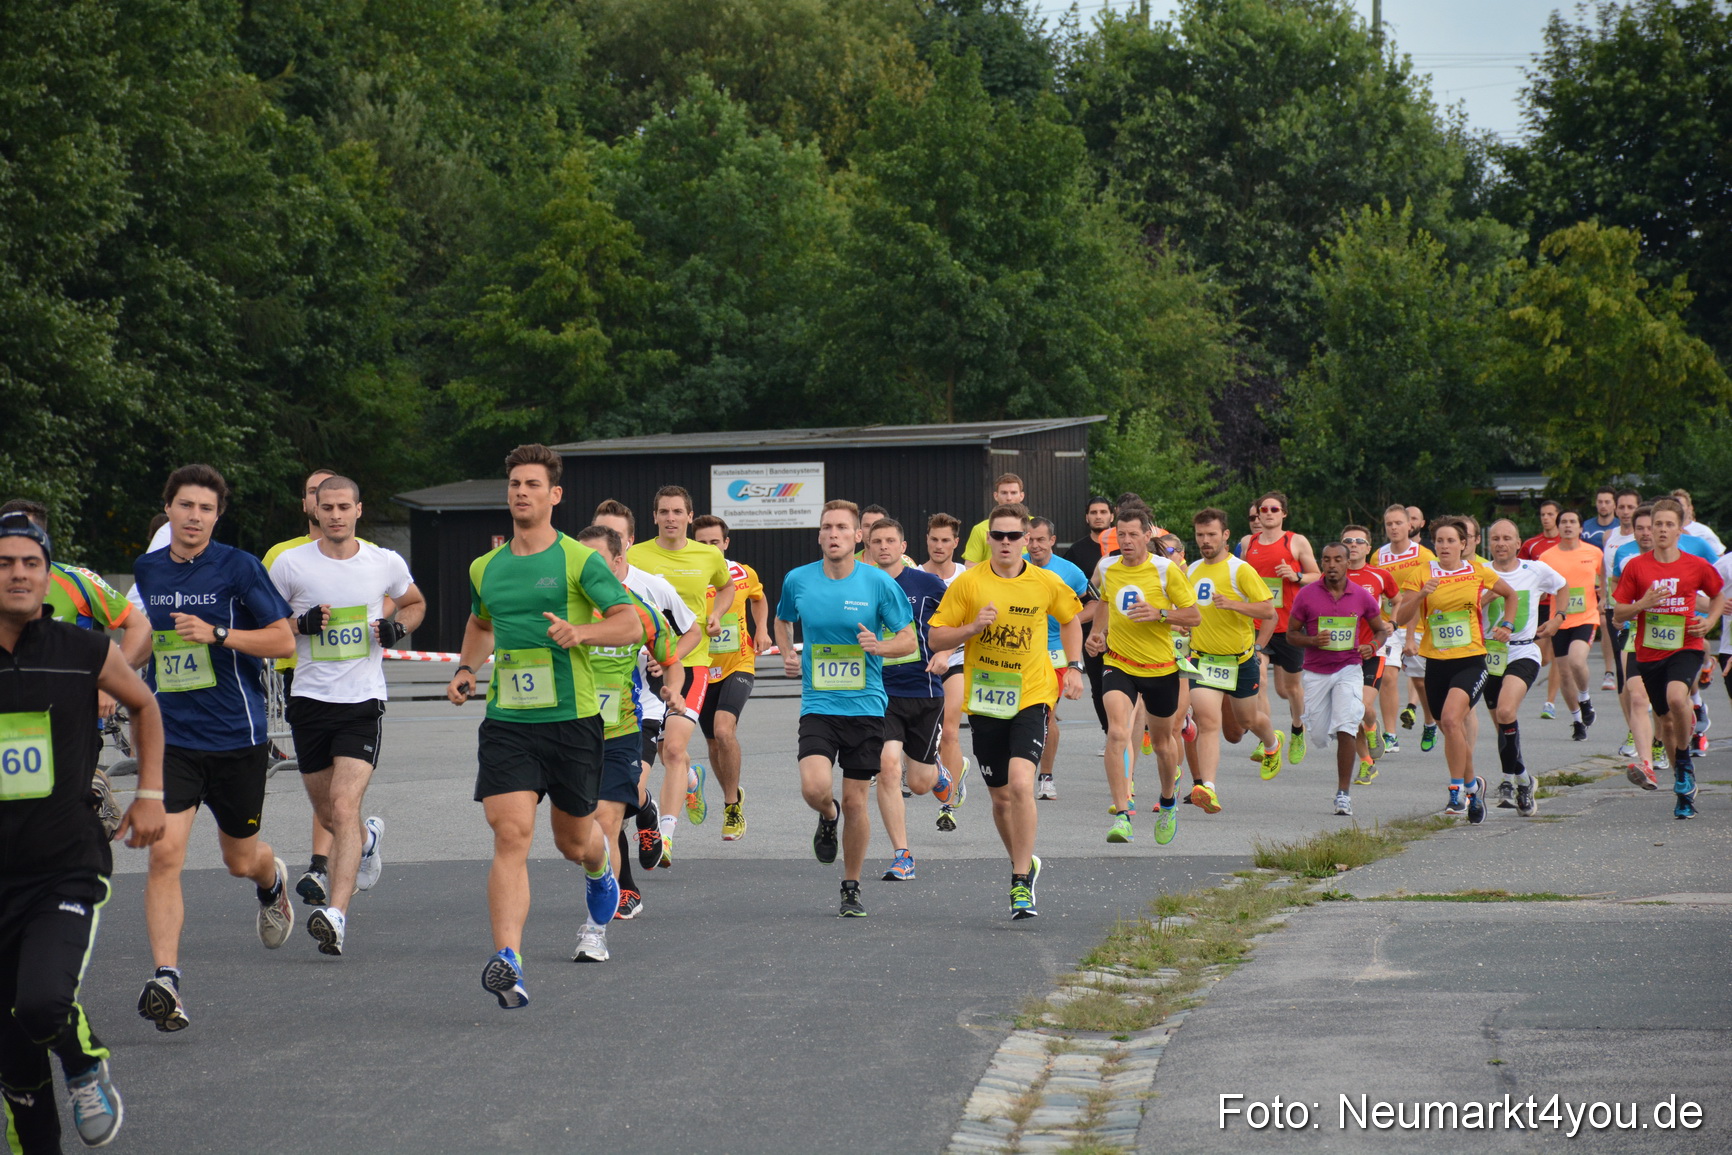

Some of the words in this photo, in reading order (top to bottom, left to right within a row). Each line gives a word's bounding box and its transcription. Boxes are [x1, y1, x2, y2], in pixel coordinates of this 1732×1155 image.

[736, 483, 778, 498] AST
[1198, 583, 1211, 600] B
[150, 595, 174, 606] EURO
[183, 593, 217, 605] POLES
[1009, 605, 1030, 614] swn
[316, 627, 363, 646] 1669
[1330, 630, 1352, 642] 659
[1439, 625, 1464, 639] 896
[1651, 627, 1676, 640] 946
[163, 653, 198, 675] 374
[818, 662, 860, 677] 1076
[979, 655, 999, 667] Alles
[1001, 660, 1022, 670] läuft
[1206, 666, 1230, 680] 158
[511, 673, 535, 692] 13
[1472, 669, 1489, 699] skinfit
[975, 687, 1016, 706] 1478
[2, 746, 42, 775] 60
